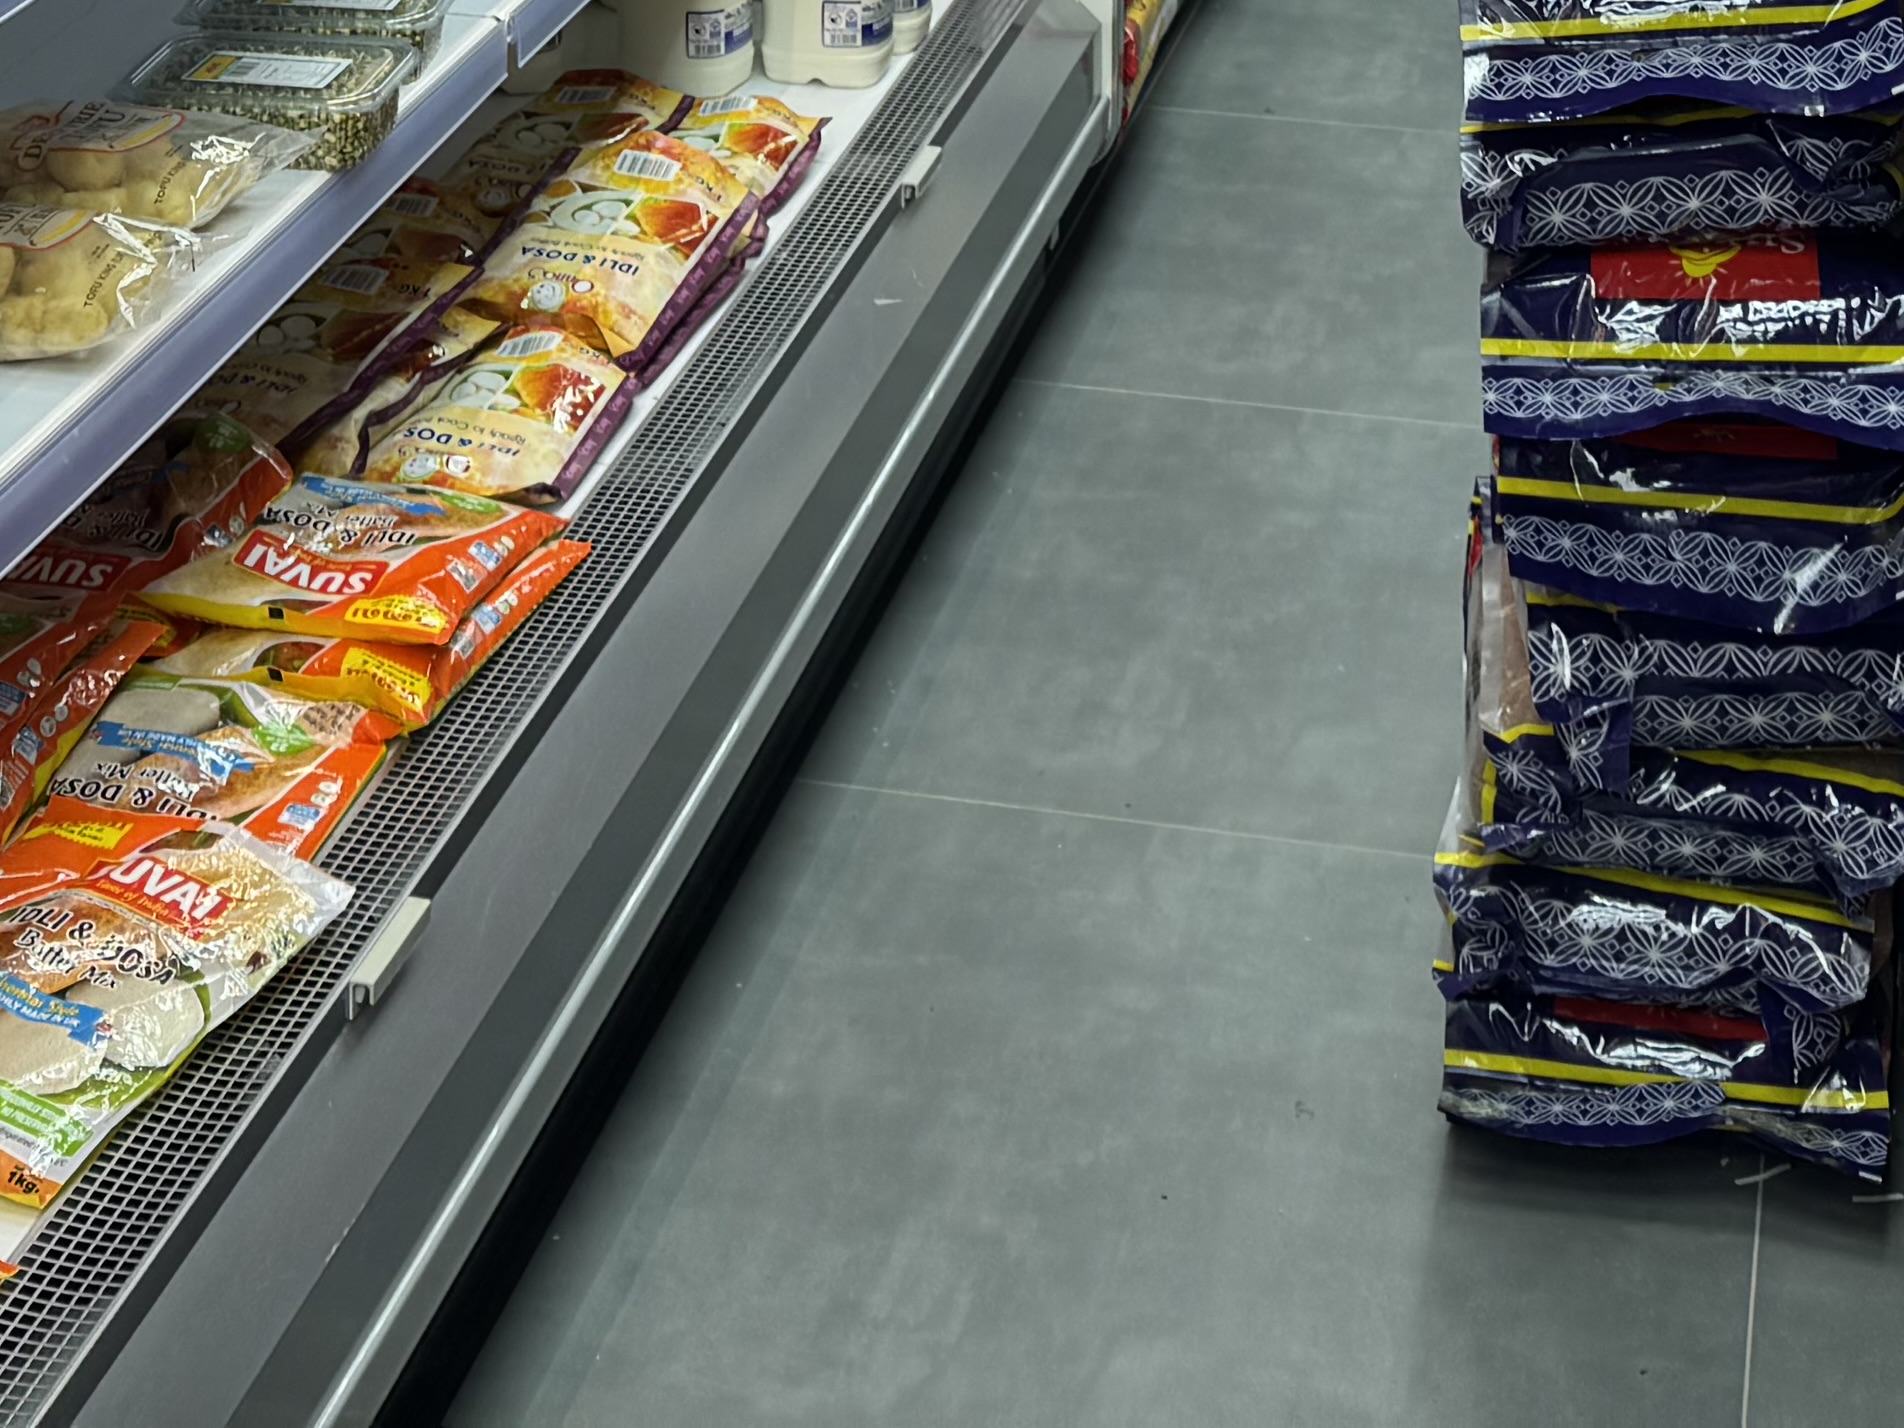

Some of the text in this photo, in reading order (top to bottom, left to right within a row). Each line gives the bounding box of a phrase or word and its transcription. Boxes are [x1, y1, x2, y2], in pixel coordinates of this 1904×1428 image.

[242, 544, 374, 594] SUVAI
[10, 904, 73, 932] IDLI
[68, 921, 94, 941] &
[80, 966, 119, 990] Mix
